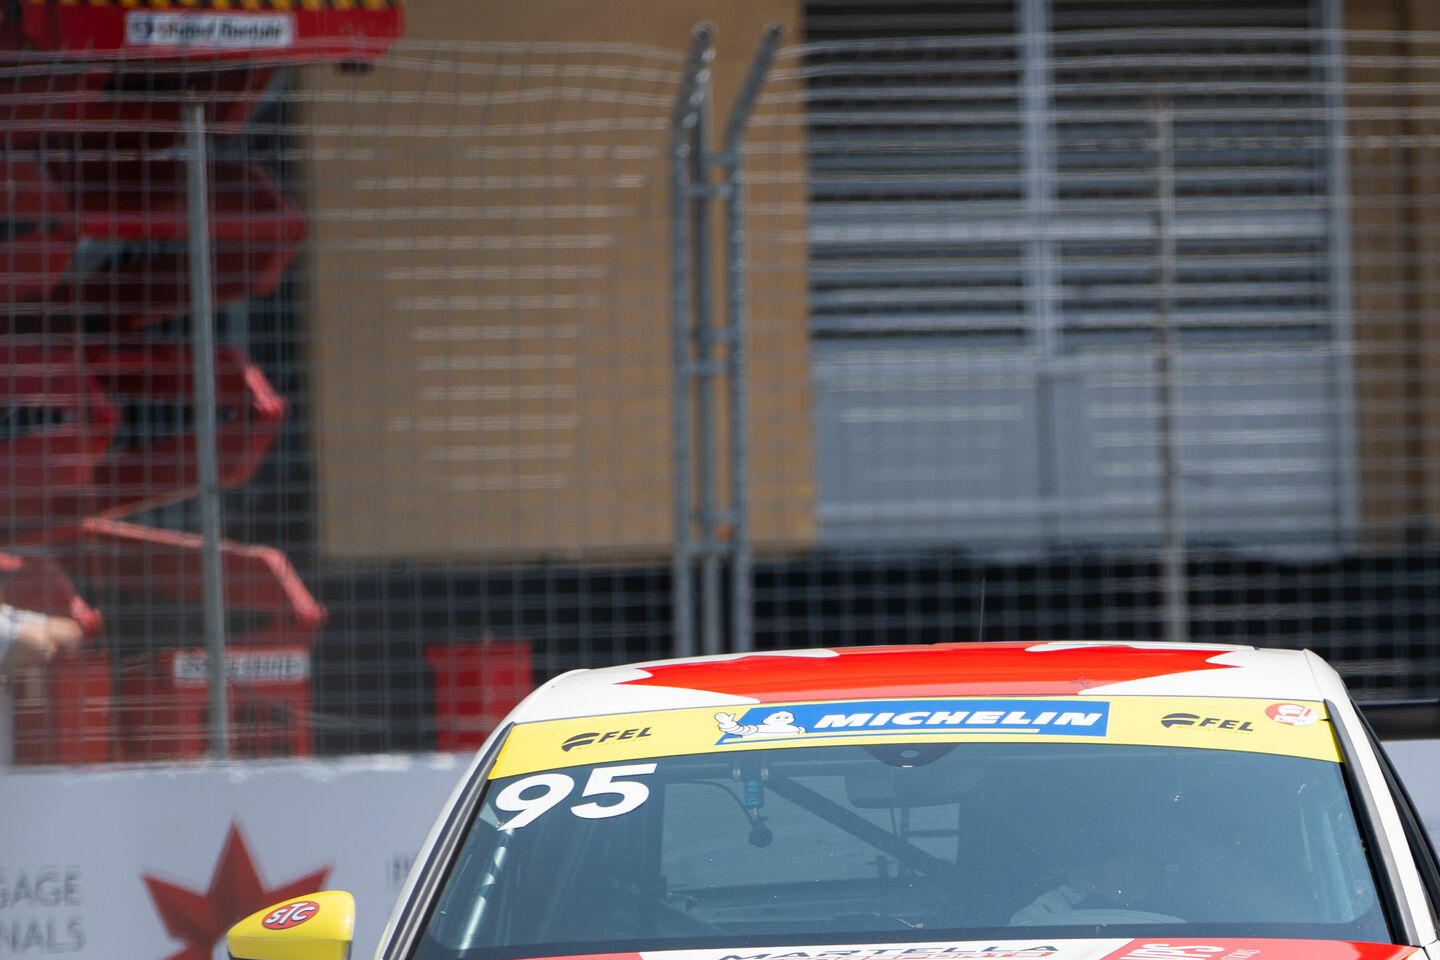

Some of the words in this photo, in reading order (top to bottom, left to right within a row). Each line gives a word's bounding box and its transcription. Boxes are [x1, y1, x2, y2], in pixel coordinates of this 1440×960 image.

[813, 711, 1102, 729] MICHELIN
[495, 763, 658, 832] 95
[265, 902, 317, 925] STC
[718, 946, 1060, 960] MARTELLA
